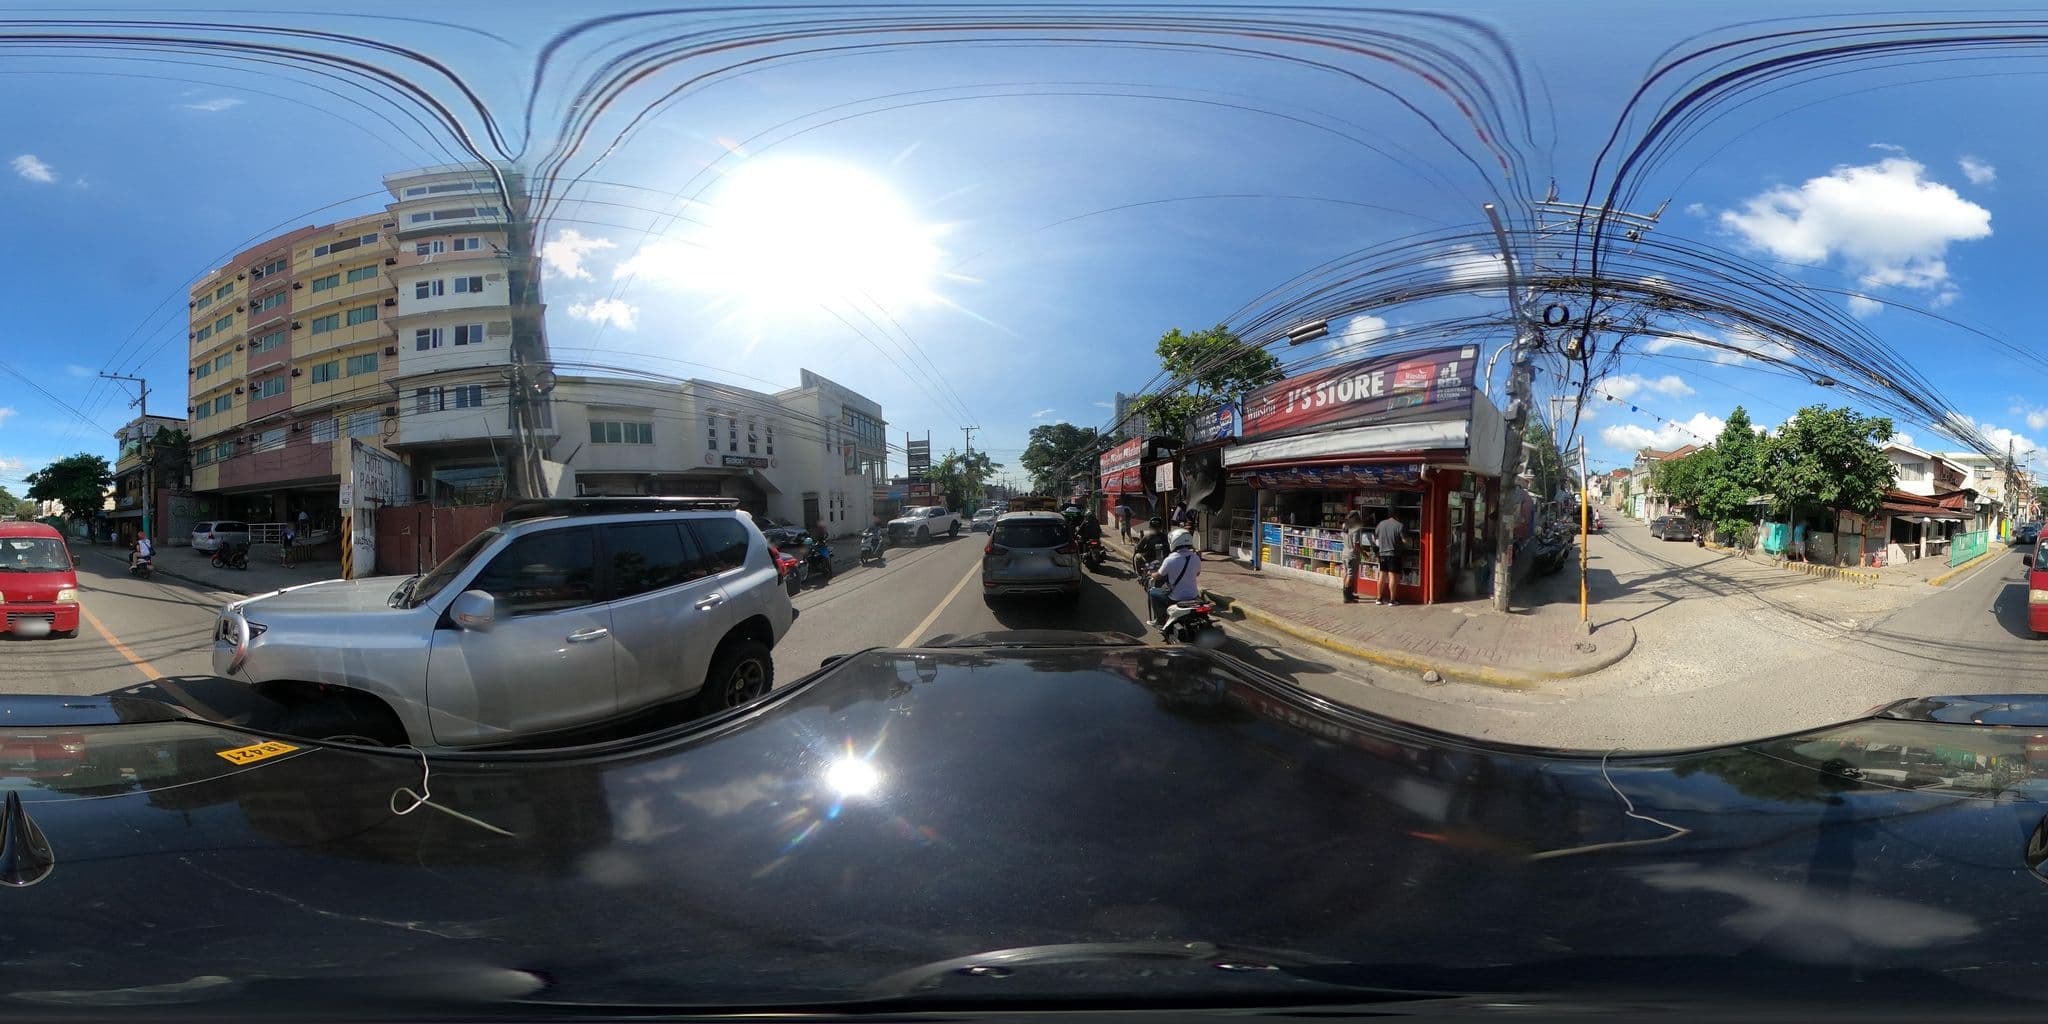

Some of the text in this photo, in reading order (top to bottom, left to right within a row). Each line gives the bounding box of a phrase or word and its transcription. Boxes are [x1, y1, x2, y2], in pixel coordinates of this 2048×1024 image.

[1440, 362, 1458, 379] #1
[1285, 371, 1385, 414] J'S STORE
[364, 455, 384, 476] HOTEL
[360, 471, 391, 496] PARKING
